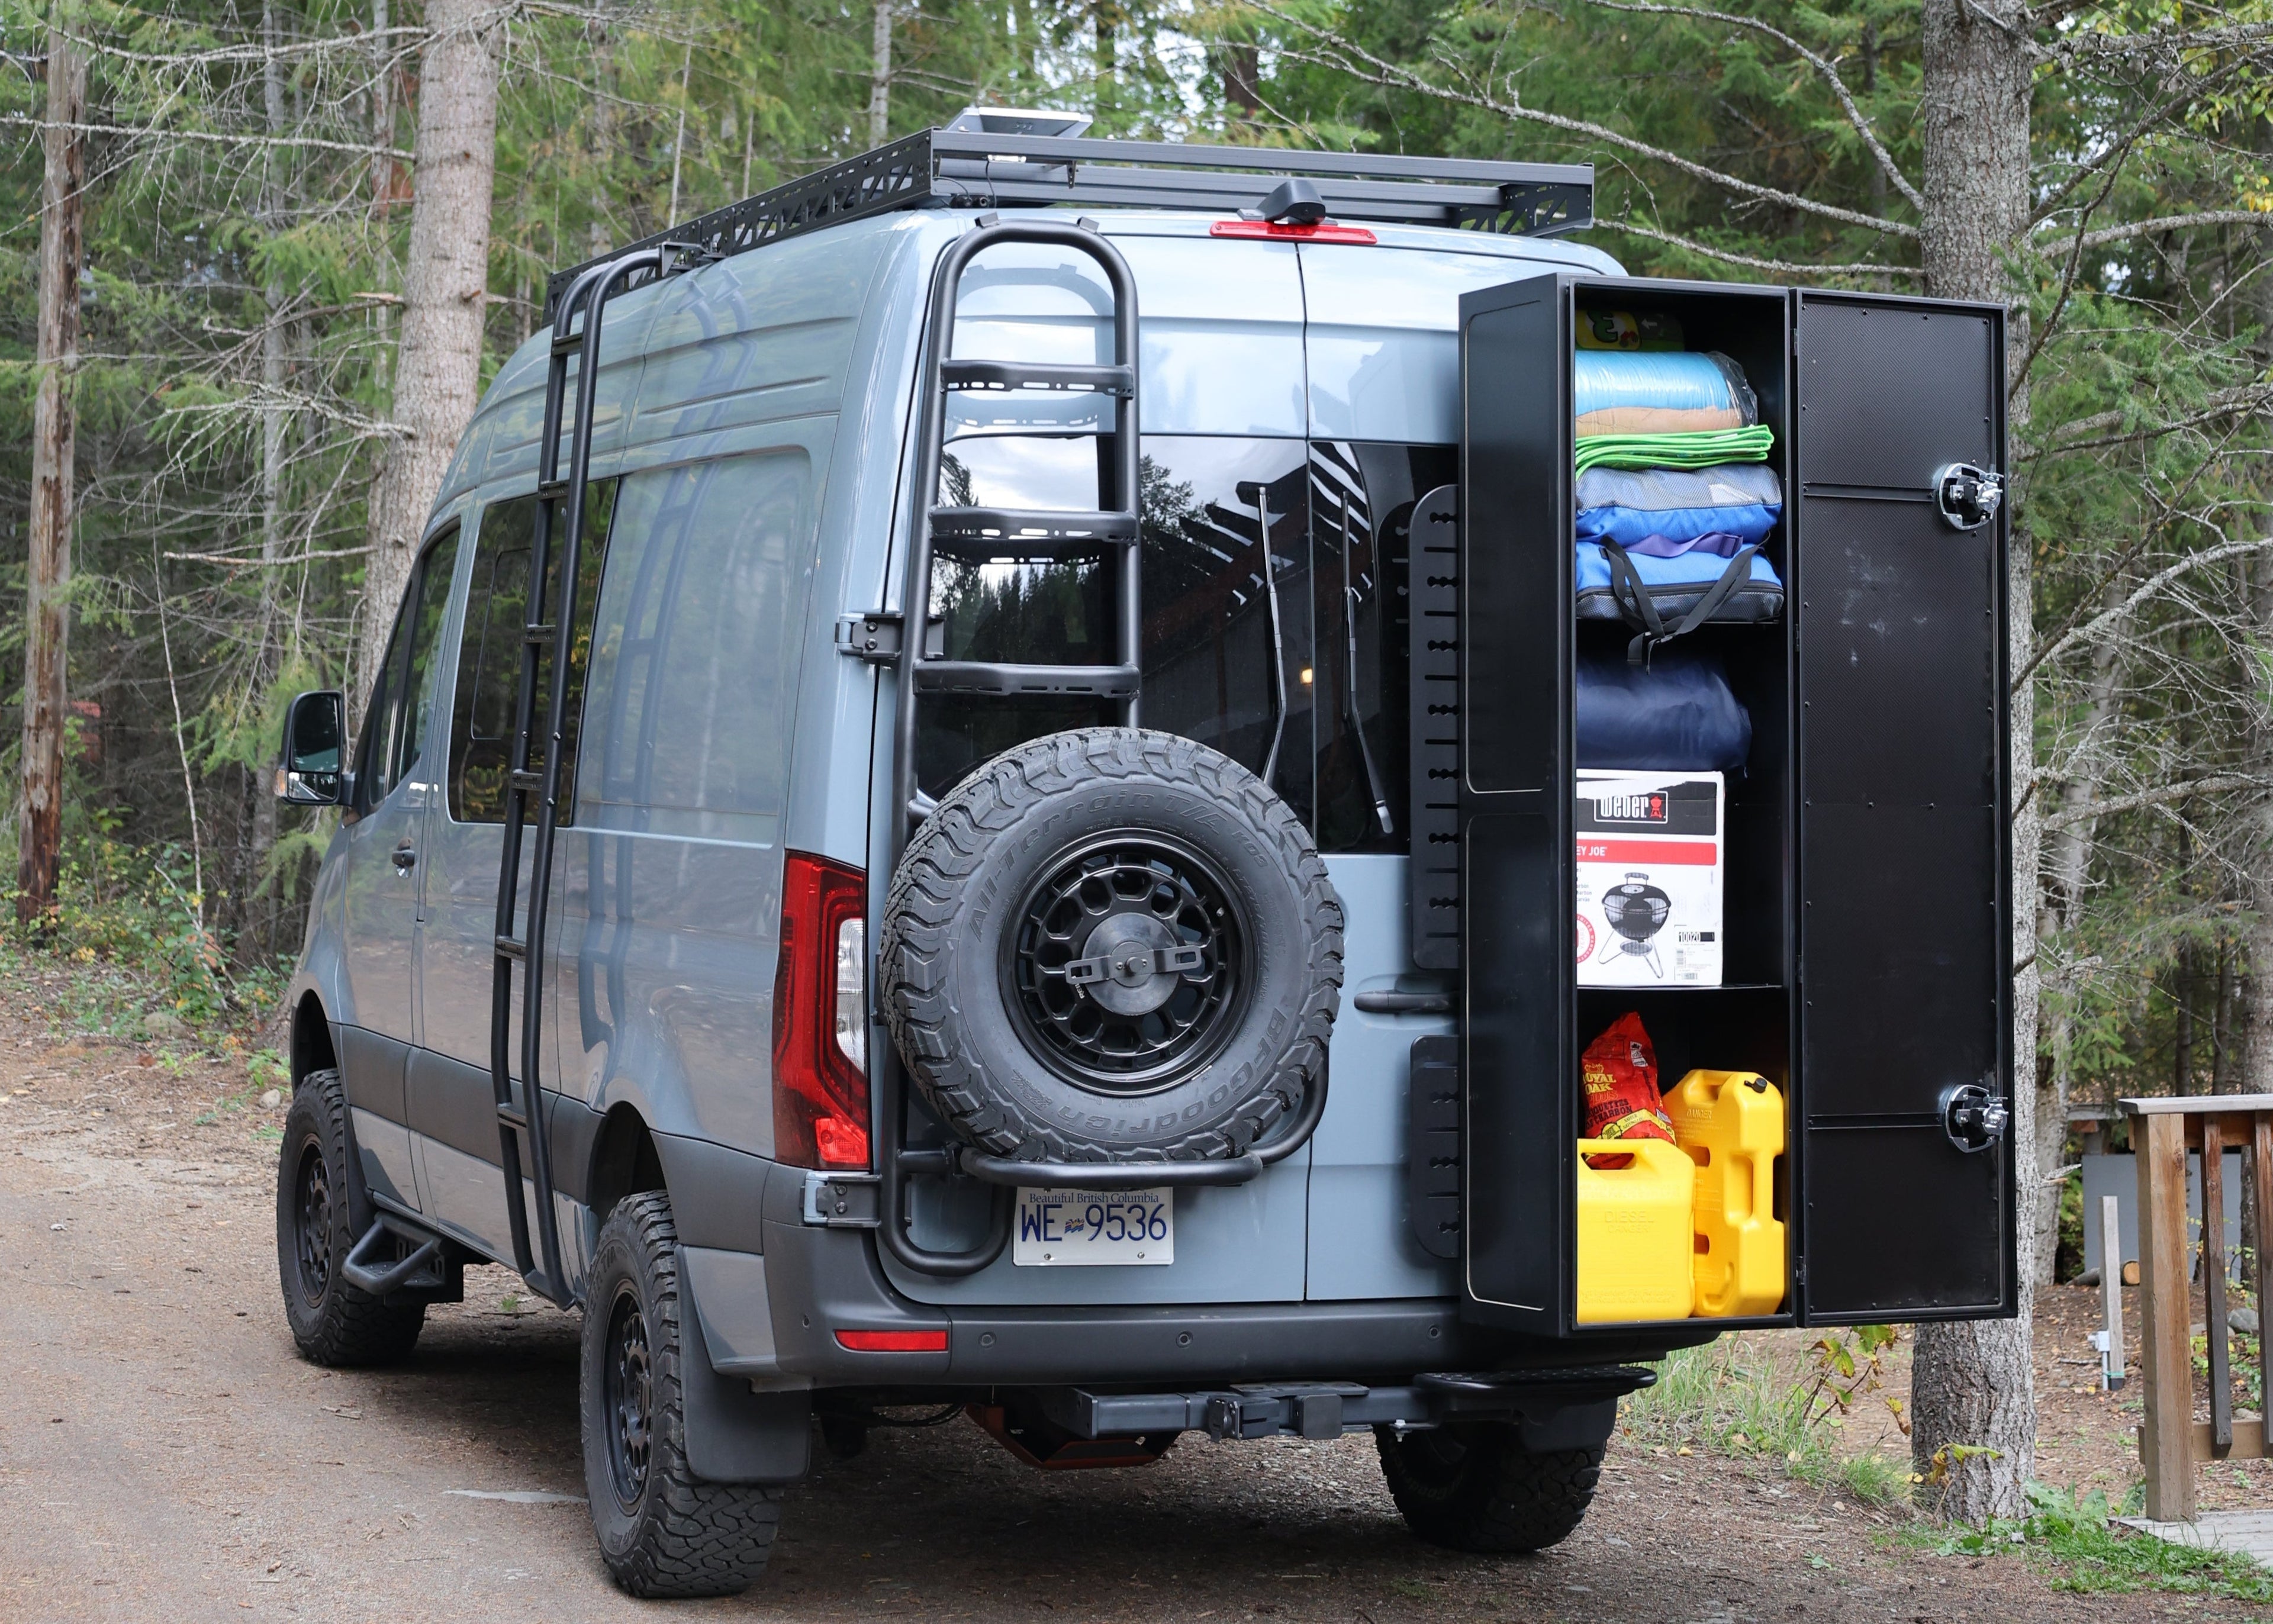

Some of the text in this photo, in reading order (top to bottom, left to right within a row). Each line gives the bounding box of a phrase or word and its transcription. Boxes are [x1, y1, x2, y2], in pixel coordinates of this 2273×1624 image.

[1588, 846, 1605, 856] JOE
[965, 790, 1155, 942] All-Terrain
[1164, 791, 1227, 836] T/A
[1054, 1006, 1289, 1138] BFGoodrich
[1585, 1083, 1614, 1095] OAK
[1687, 1109, 1712, 1119] DANGER
[1029, 1193, 1159, 1203] Beautiful British Columbia
[1021, 1203, 1167, 1242] WE 9536
[1605, 1211, 1654, 1223] DIESEL
